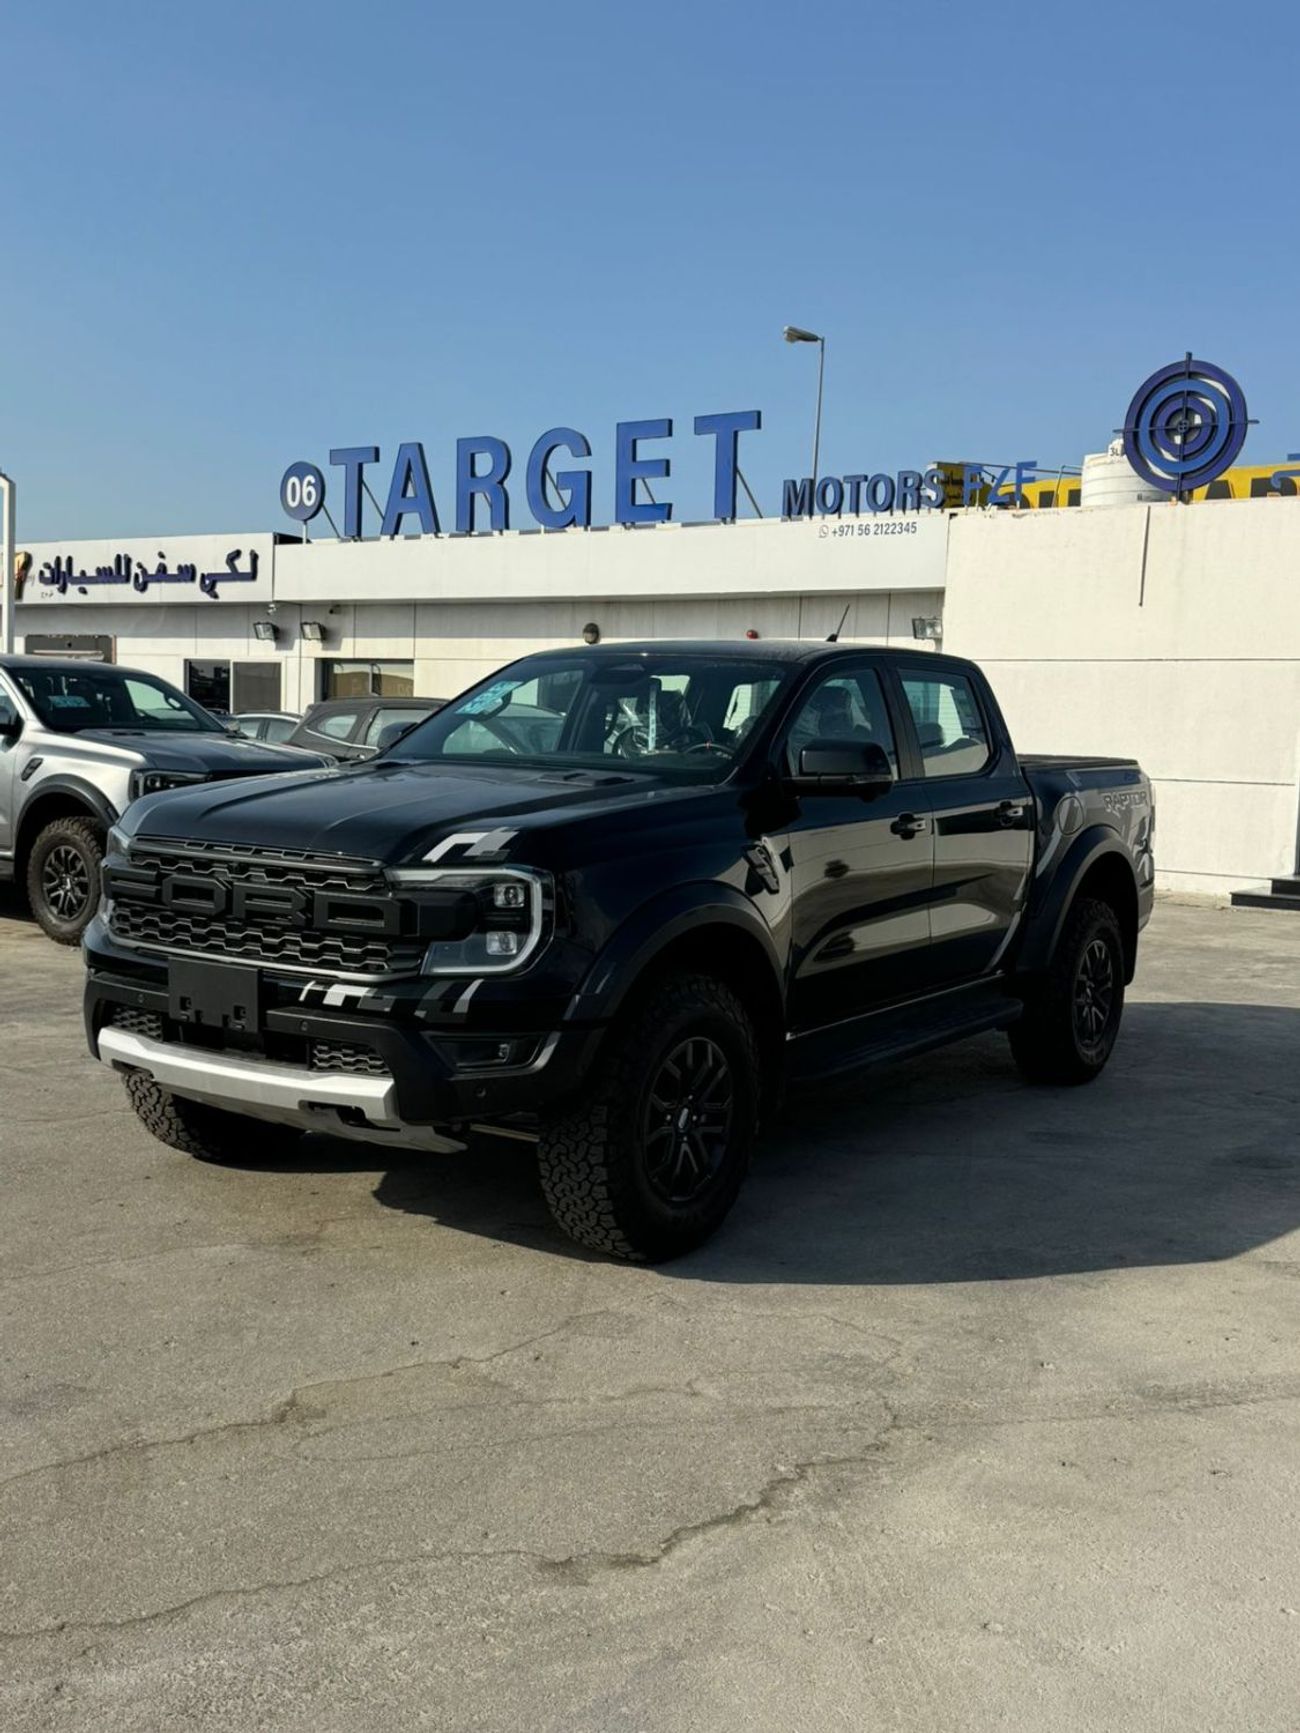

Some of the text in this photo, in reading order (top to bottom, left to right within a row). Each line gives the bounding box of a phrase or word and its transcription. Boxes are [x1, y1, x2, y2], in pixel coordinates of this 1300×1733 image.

[286, 475, 316, 507] 06
[329, 410, 762, 538] TARGET
[782, 469, 948, 516] MOTORS
[831, 522, 917, 537] +971 56 2122345
[39, 553, 132, 594] للسيارات
[134, 551, 197, 593] سفن
